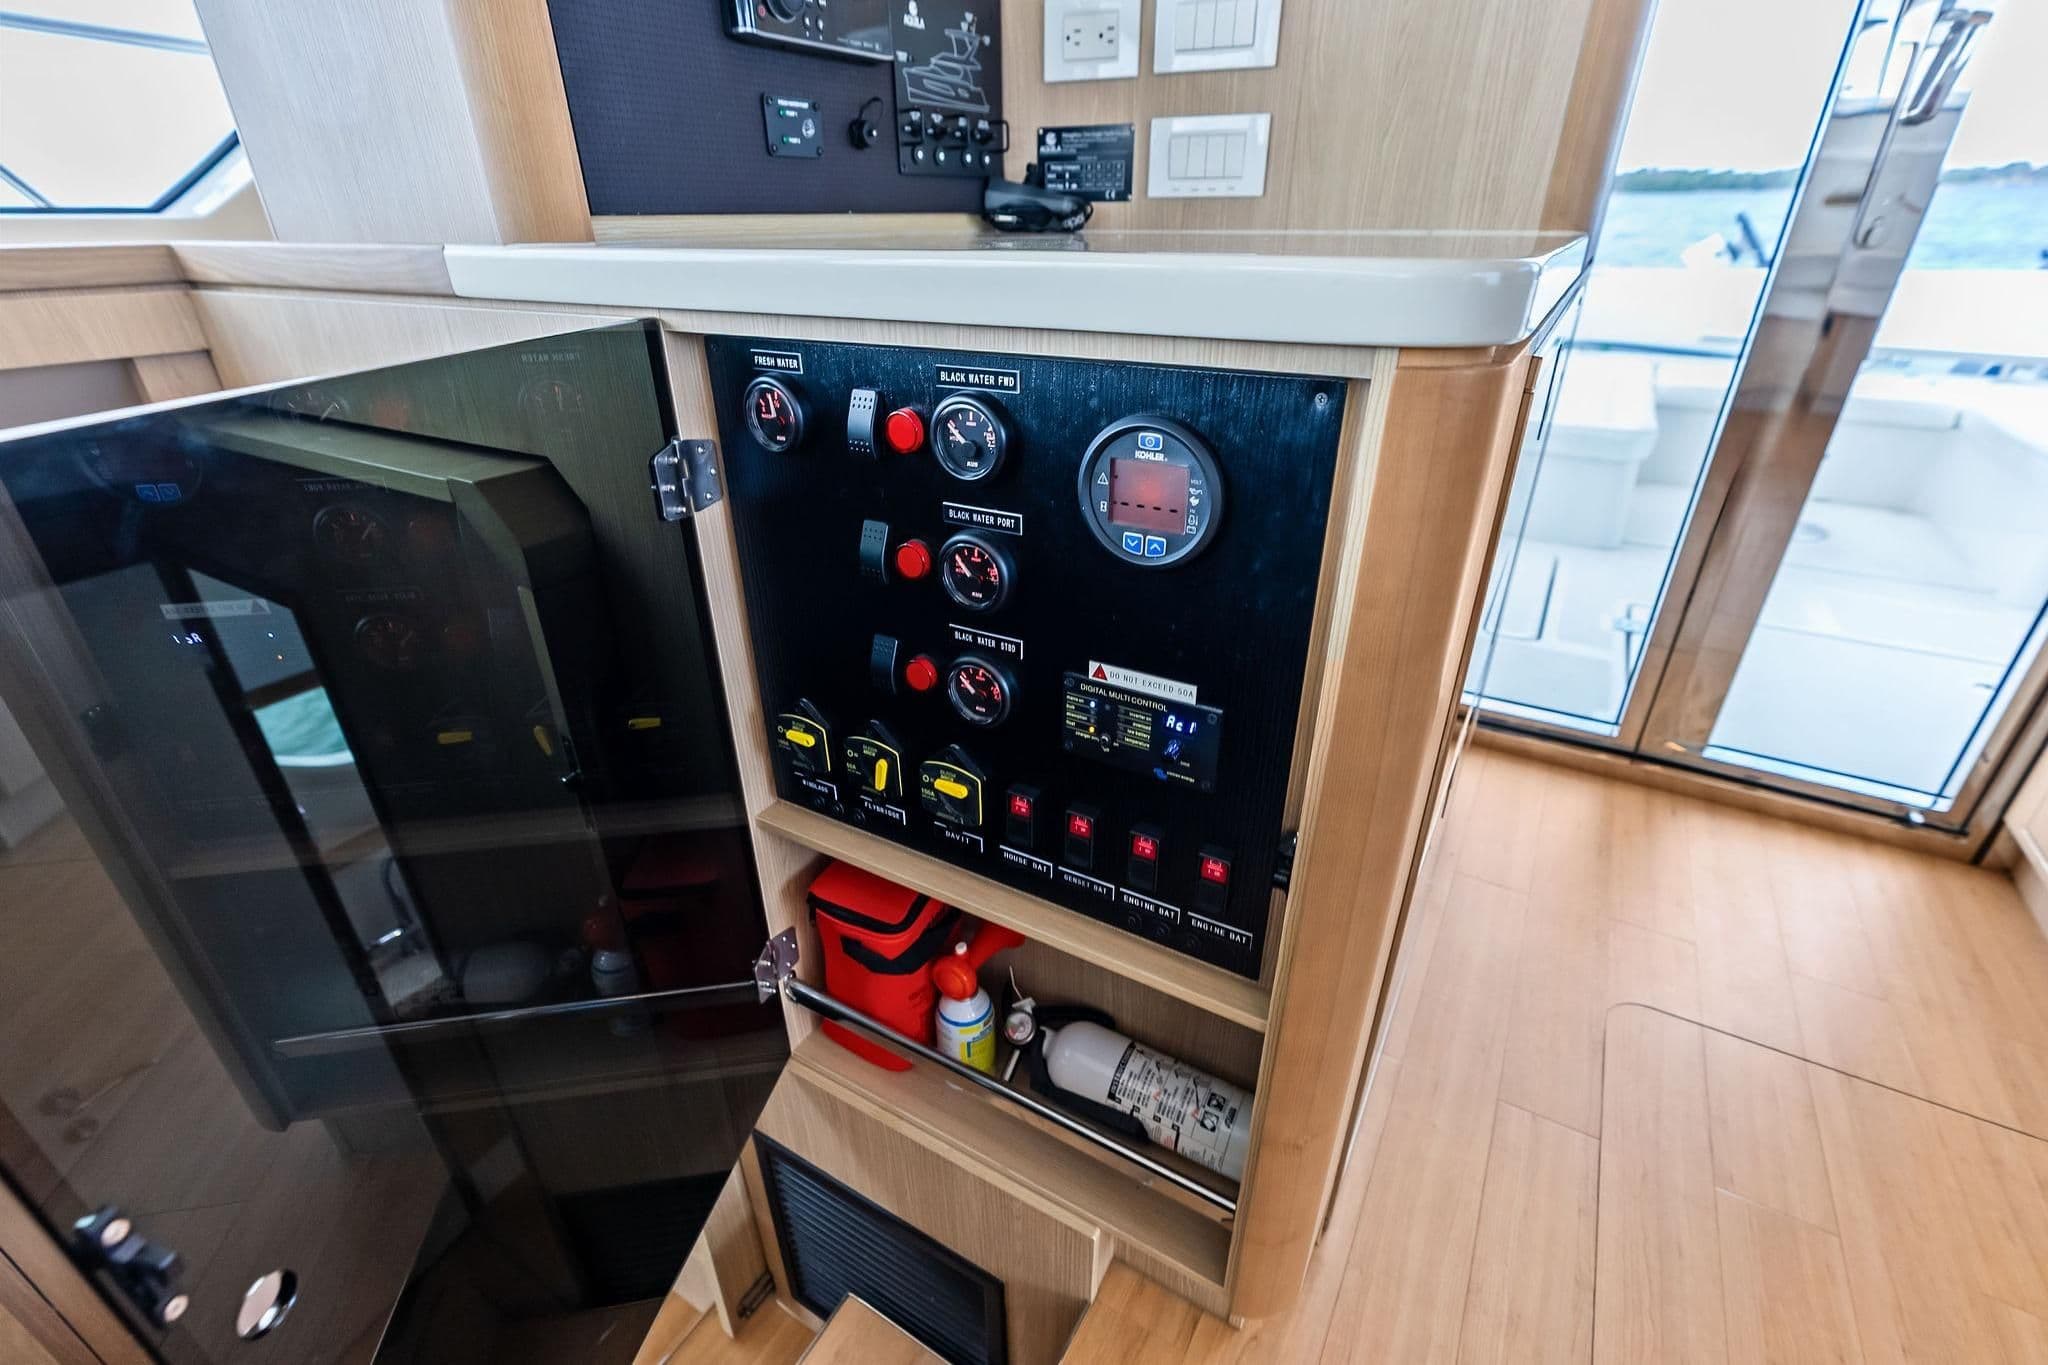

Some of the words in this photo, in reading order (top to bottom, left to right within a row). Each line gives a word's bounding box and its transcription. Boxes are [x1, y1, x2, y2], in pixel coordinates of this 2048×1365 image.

[754, 355, 775, 367] FRESH
[776, 357, 798, 369] WATER
[940, 371, 966, 382] BLACK
[968, 373, 995, 385] WATER
[998, 375, 1015, 387] FWD
[1135, 450, 1164, 461] KOHLER
[949, 509, 970, 521] BLACK
[973, 513, 995, 525] WATER
[997, 517, 1015, 529] PORT
[955, 630, 973, 643] BLACK
[977, 636, 996, 648] WATER
[1109, 671, 1120, 680] DO
[1123, 674, 1138, 684] NOT
[1142, 679, 1174, 694] EXCEED
[1080, 683, 1107, 698] DIGITAL
[1108, 690, 1131, 703] MULTI
[1131, 696, 1168, 712] CONTROL
[945, 830, 969, 845] DAVIT
[1003, 851, 1028, 866] HOUSE
[1032, 861, 1047, 873] BAT
[1063, 873, 1090, 888] GENSET
[1093, 885, 1107, 895] BAT
[1123, 894, 1155, 912] ENGINE
[1158, 907, 1175, 920] BAT
[1191, 918, 1225, 937] ENGINE
[1229, 932, 1247, 944] BAT
